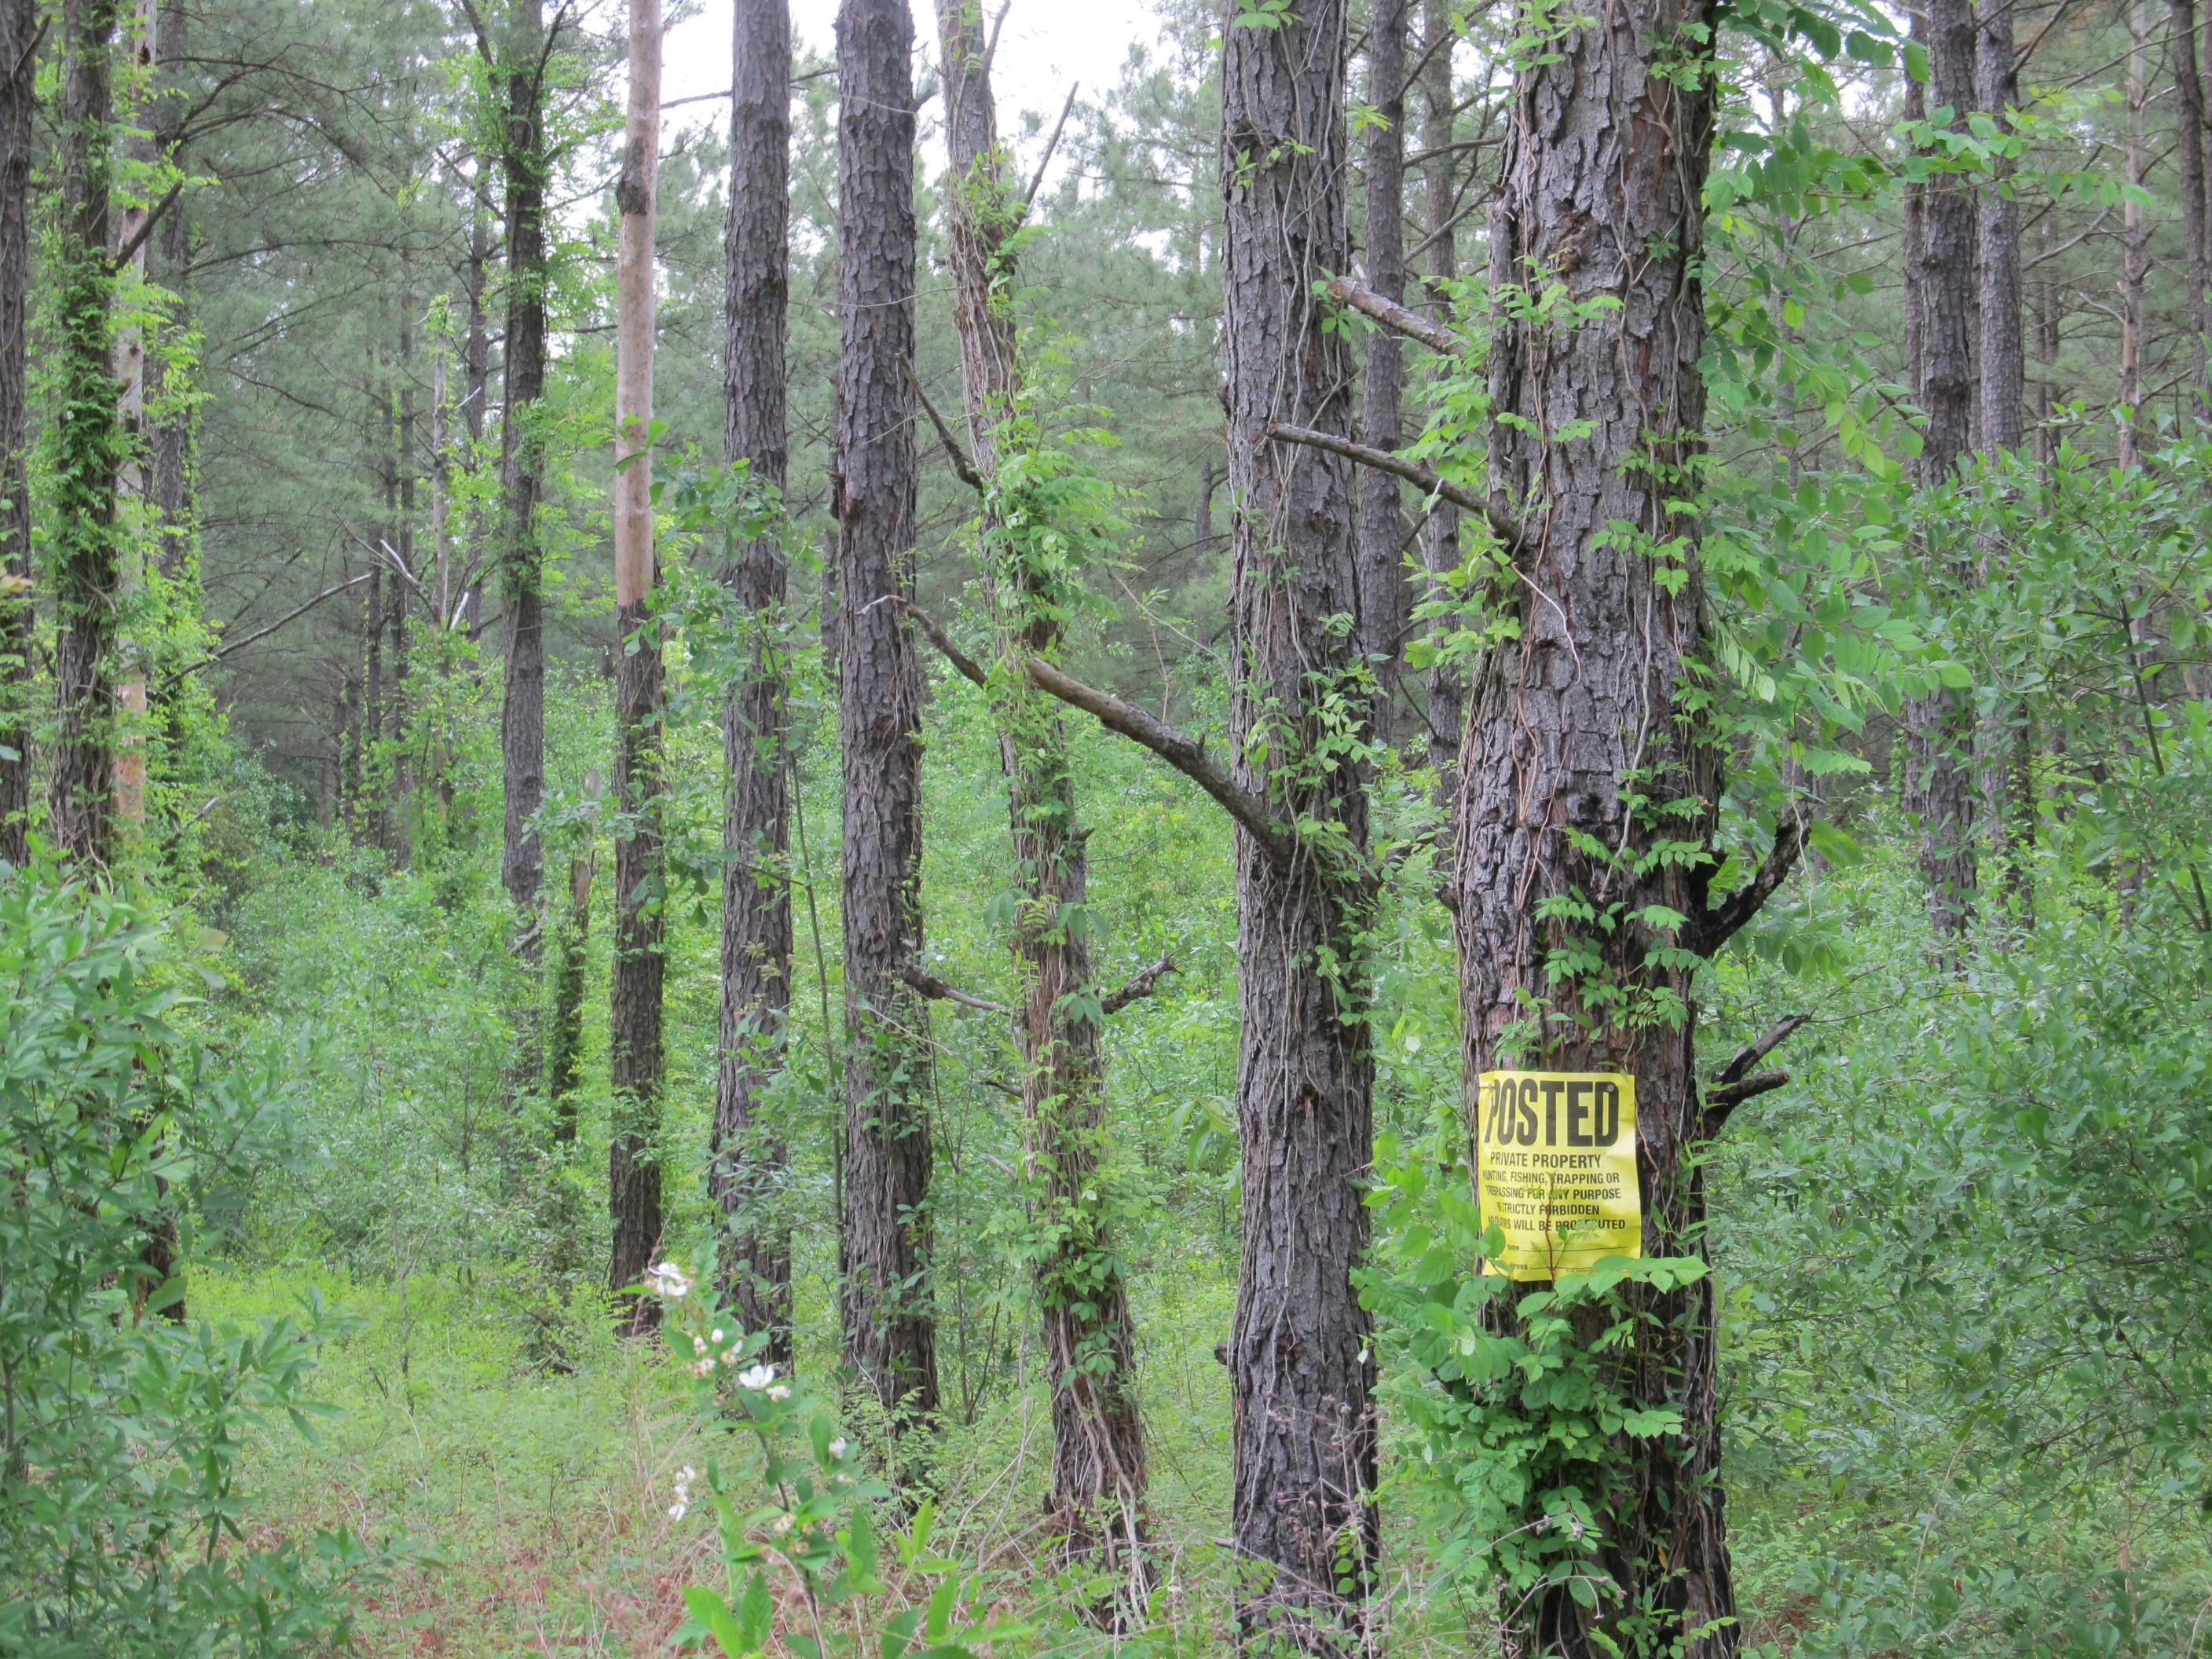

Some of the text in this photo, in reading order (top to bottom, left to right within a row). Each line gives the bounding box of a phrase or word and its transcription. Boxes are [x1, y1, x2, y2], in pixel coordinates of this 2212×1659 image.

[1483, 1078, 1619, 1147] POSTED
[1490, 1152, 1601, 1169] PRIVATE PROPERTY
[1511, 1171, 1547, 1185] FISHING,
[1606, 1172, 1620, 1183] OR
[1528, 1188, 1545, 1199] FOR
[1573, 1188, 1621, 1199] PURPOSE
[1540, 1204, 1599, 1216] FORBIDDEN
[1514, 1219, 1536, 1231] WILL
[1539, 1221, 1552, 1232] BE
[1555, 1219, 1626, 1231] PROUTED
